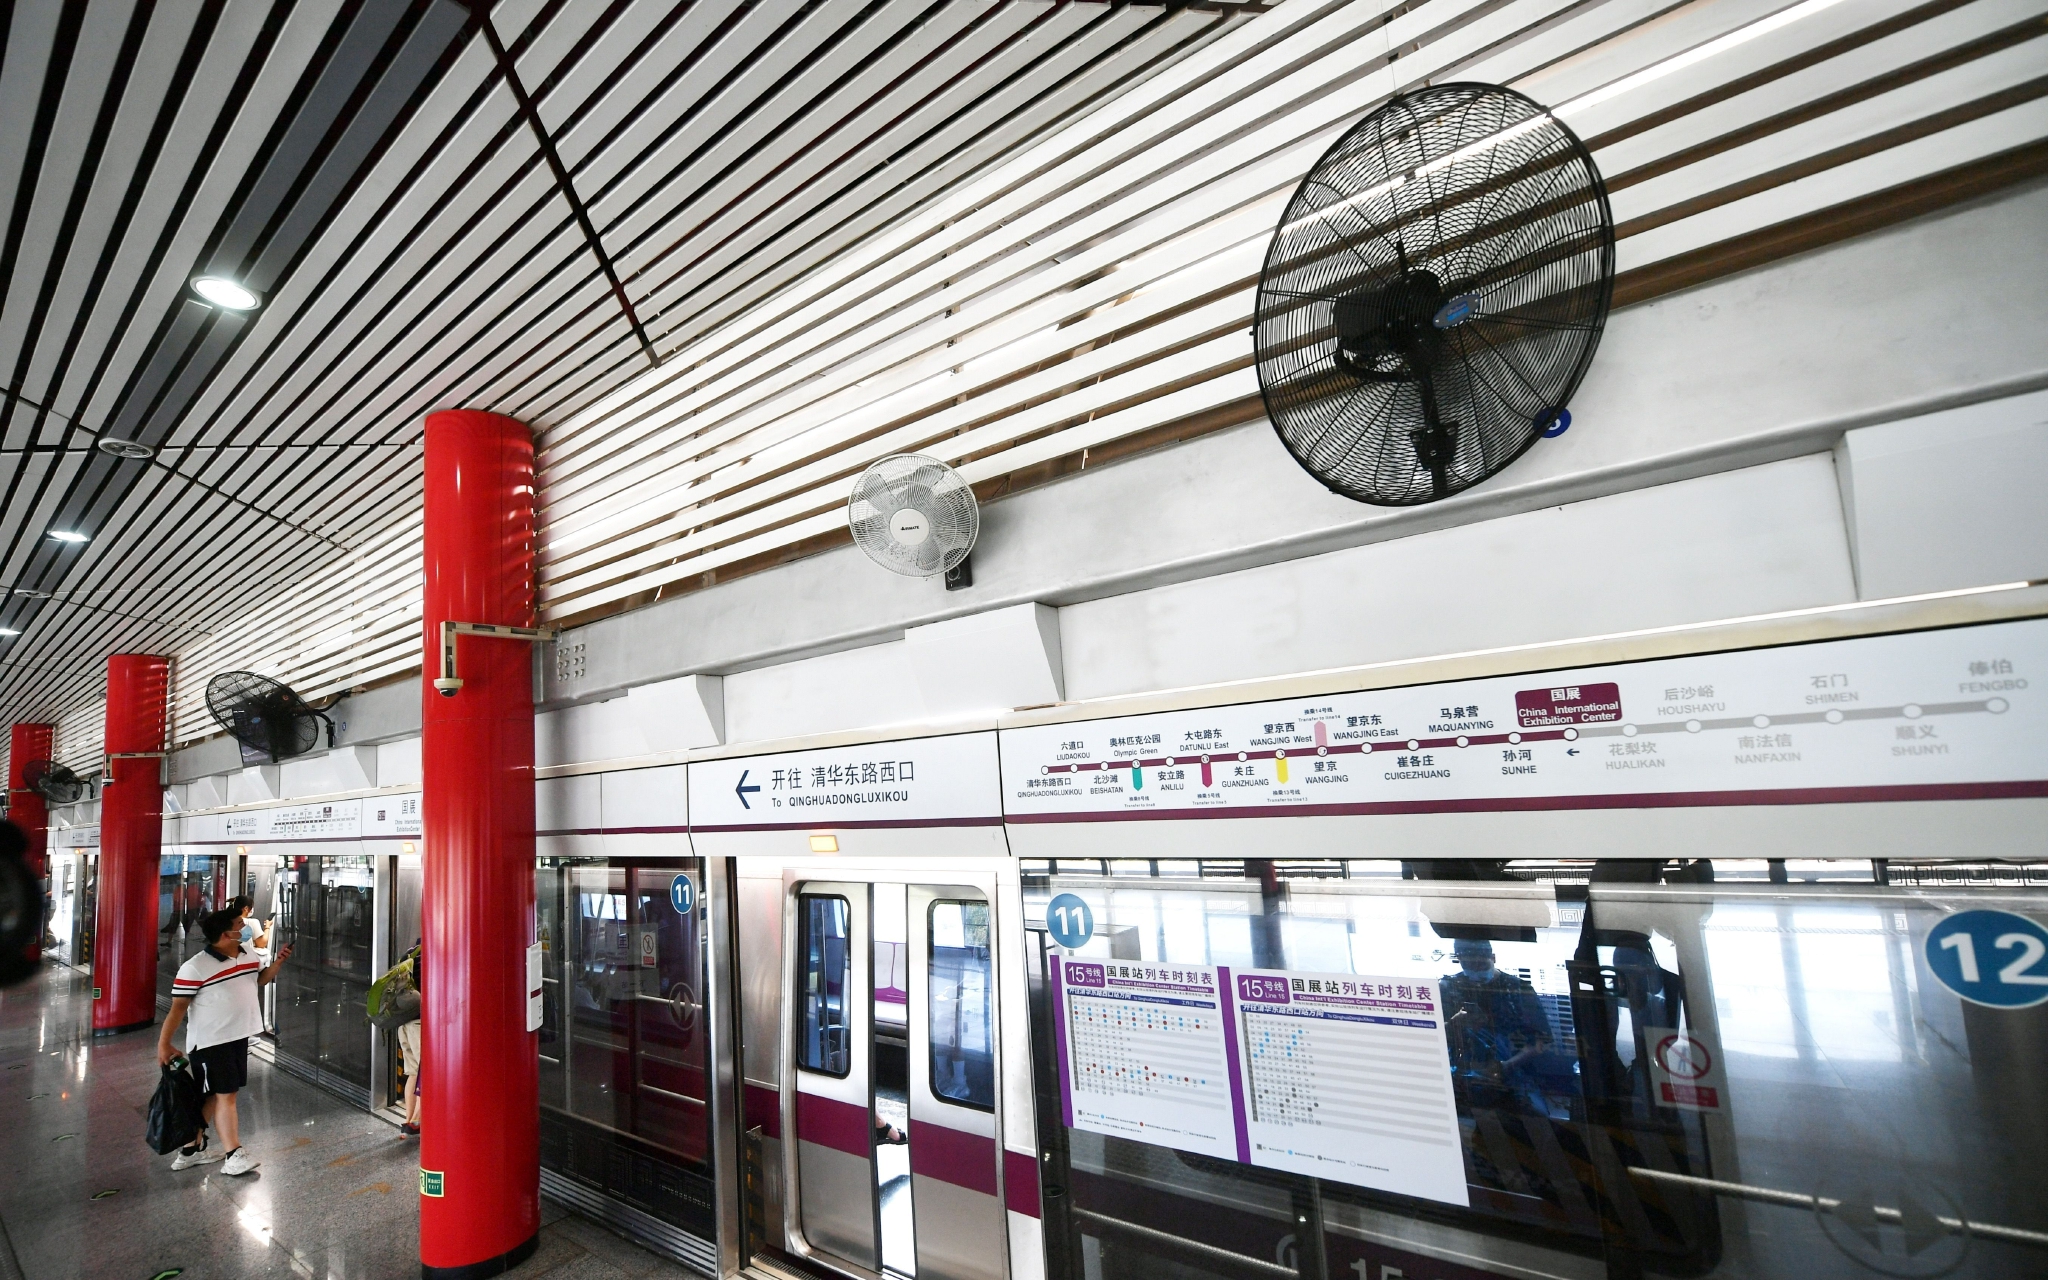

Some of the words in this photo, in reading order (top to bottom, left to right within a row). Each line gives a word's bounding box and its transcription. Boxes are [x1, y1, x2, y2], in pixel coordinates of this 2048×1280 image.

[1968, 659, 2014, 676] 俸伯
[1810, 674, 1849, 689] 石门
[1959, 678, 2028, 693] FENGBO
[1551, 688, 1581, 702] 国展
[1664, 685, 1714, 701] 后沙峪
[1805, 692, 1859, 704] SHIMEN
[1440, 705, 1479, 719] 马泉营
[1519, 708, 1547, 717] China
[1554, 701, 1618, 714] International
[1658, 702, 1725, 716] HOUSHAYU
[1347, 714, 1382, 727] 望京东
[1523, 714, 1573, 726] Exhibition
[1581, 711, 1616, 722] Center
[1264, 722, 1295, 734] 望京西
[1428, 720, 1494, 733] MAQUANYING
[1896, 725, 1937, 740] 顺义
[1110, 734, 1161, 747] 奥林匹克公园
[1185, 729, 1222, 740] 大屯路东
[1250, 736, 1290, 746] WANGJING
[1294, 735, 1312, 743] West
[1333, 730, 1378, 740] WANGJING
[1381, 728, 1399, 736] East
[1061, 741, 1084, 750] 六道口
[1180, 743, 1212, 752] DATUNLU
[1738, 734, 1792, 749] 南法信
[1114, 749, 1137, 757] Olympic
[1609, 742, 1657, 756] 花梨坎
[1892, 744, 1949, 756] SHUNYI
[1057, 752, 1090, 760] LIUDAOKOU
[1397, 755, 1434, 768] 崔各庄
[1503, 750, 1532, 762] 孙河
[1735, 751, 1801, 765] NANFAXIN
[1235, 766, 1255, 776] 关庄
[1314, 761, 1337, 772] 望京
[1502, 765, 1537, 775] SUNHE
[1605, 758, 1665, 771] HUALIKAN
[772, 768, 802, 790] 开往
[811, 761, 914, 788] 清华东路西口
[1094, 775, 1118, 784] 北沙滩
[1158, 771, 1184, 780] 安立路
[1305, 775, 1348, 784] WANGJING
[1384, 769, 1450, 780] CUIGEZHUANG
[1027, 778, 1071, 788] 清华东路西口
[1222, 778, 1269, 788] GUANZHUANG
[772, 798, 781, 807] To
[789, 791, 908, 807] QINGHUADONGLUXIKOU
[1018, 789, 1082, 798] QINGHUADONGLUXIKOU
[675, 884, 690, 904] 11
[1055, 906, 1086, 936] 11
[1940, 932, 2048, 985] 12
[1068, 966, 1085, 982] 15
[1086, 968, 1101, 977] 号线
[1106, 966, 1212, 985] 国展站列车时刻表
[1242, 979, 1263, 998] 15
[1264, 981, 1284, 992] 号线
[1292, 979, 1432, 1000] 国展站列车时刻表
[1243, 1004, 1324, 1017] 开往清华东路西口站方向
